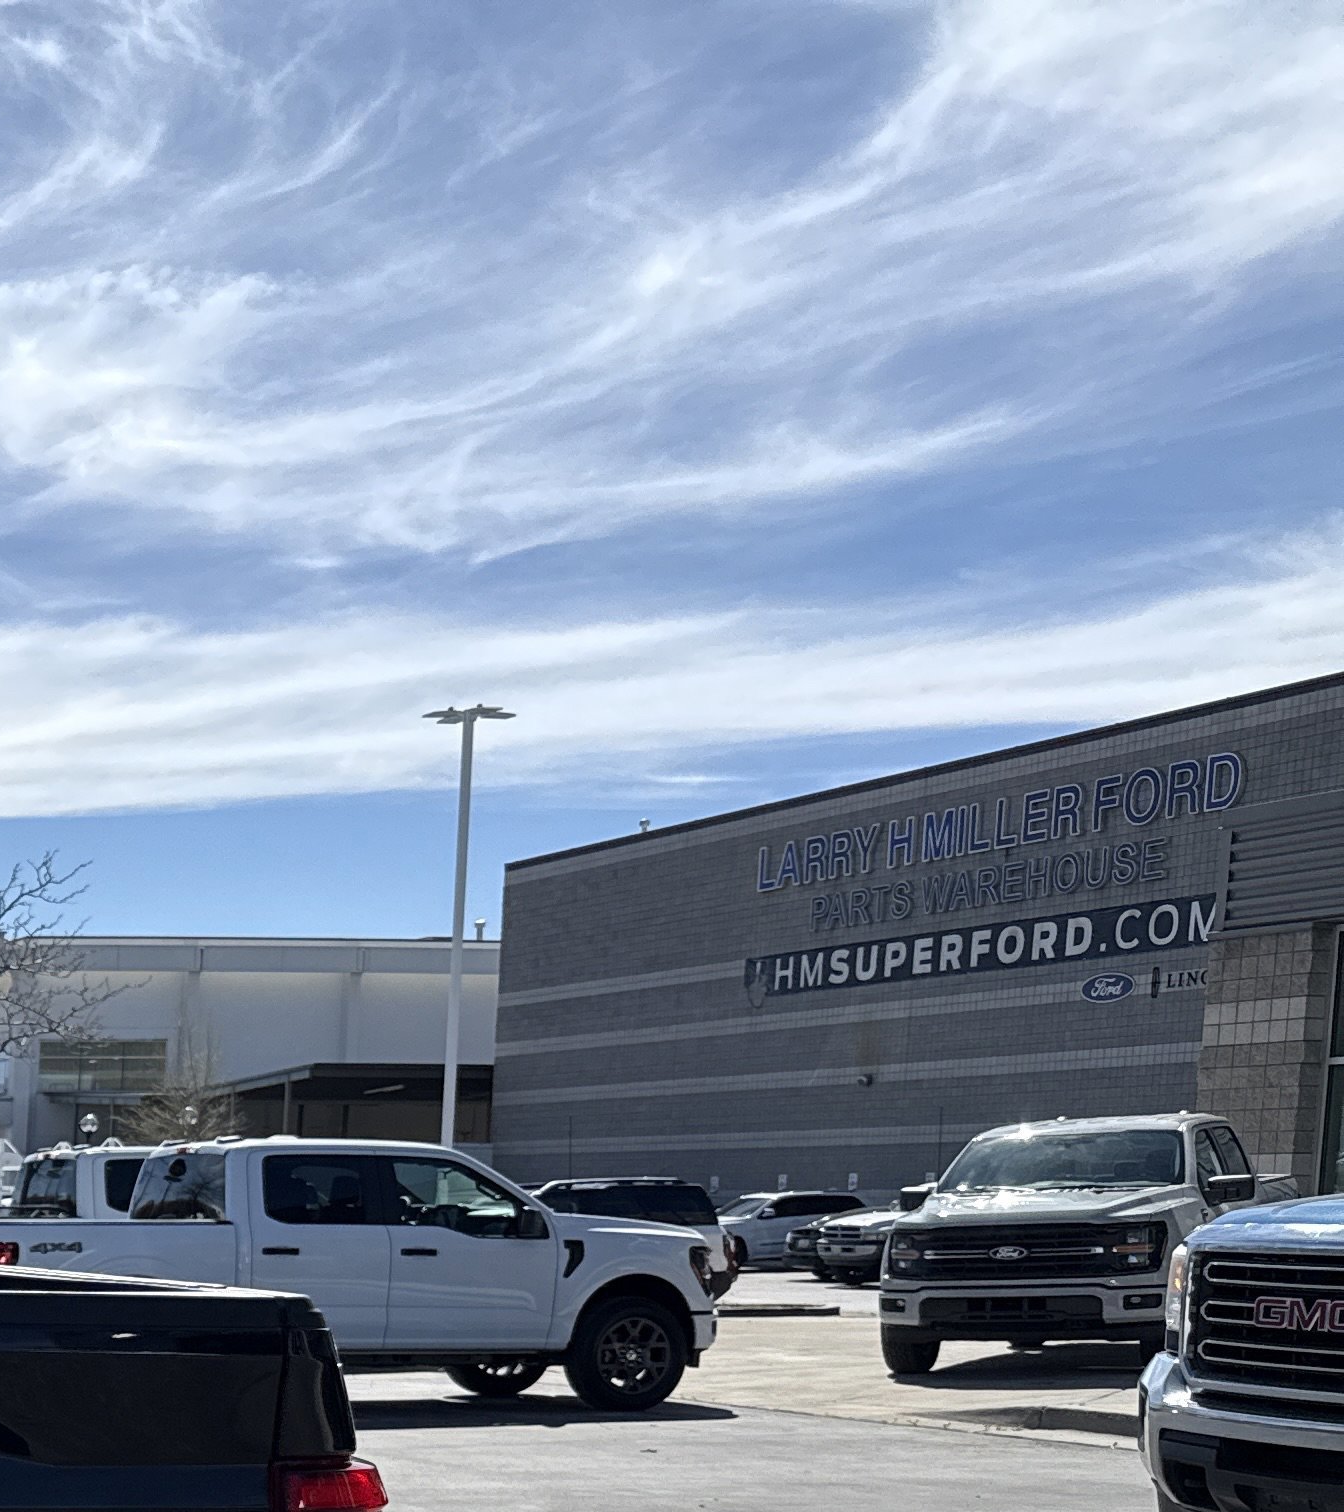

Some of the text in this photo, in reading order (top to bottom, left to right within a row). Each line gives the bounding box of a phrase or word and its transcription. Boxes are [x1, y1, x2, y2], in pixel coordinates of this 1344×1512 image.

[757, 752, 1241, 892] LARRY H MILLER FORD
[810, 837, 1166, 931] PARTS WAREHOUSE
